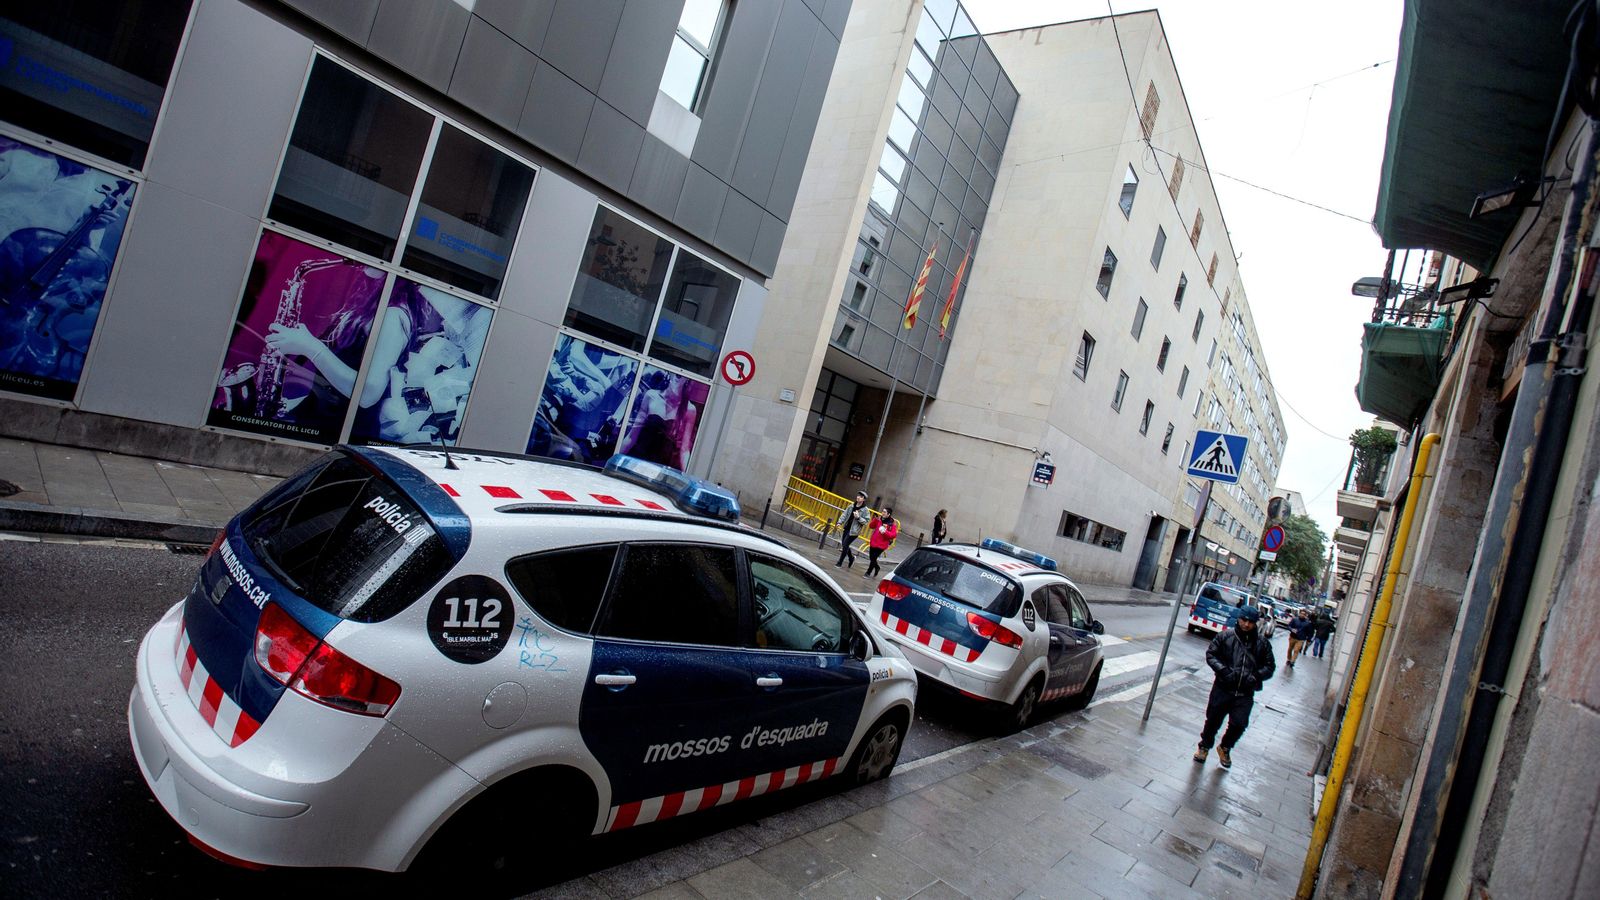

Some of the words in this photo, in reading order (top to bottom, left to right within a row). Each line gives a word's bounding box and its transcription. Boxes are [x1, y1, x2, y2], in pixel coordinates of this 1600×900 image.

[231, 414, 285, 430] CONSERVATORI
[300, 427, 320, 435] LICEU
[364, 495, 411, 534] policia
[219, 537, 272, 610] www.mossos.cat
[980, 571, 1007, 587] policia
[443, 597, 502, 628] 112
[1024, 608, 1034, 620] 112
[872, 669, 889, 682] policia
[643, 735, 732, 764] mossos
[741, 717, 829, 750] d'esquadra
